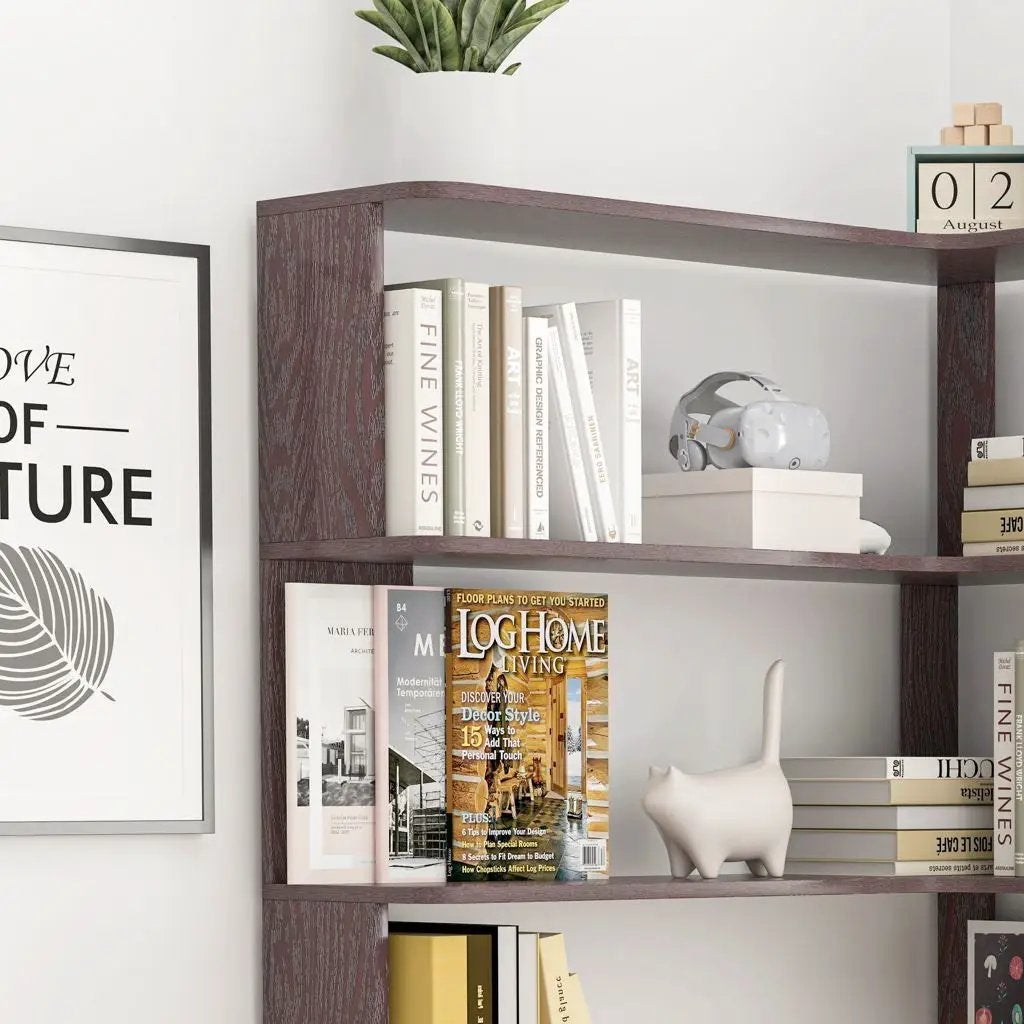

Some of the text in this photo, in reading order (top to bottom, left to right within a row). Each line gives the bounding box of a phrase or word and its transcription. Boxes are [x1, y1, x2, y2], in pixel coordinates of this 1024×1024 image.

[943, 219, 1003, 232] August
[420, 323, 437, 390] FINE
[626, 358, 640, 396] ART
[535, 337, 544, 498] GRAPHIC DESIGN REFERENCED
[421, 405, 438, 503] WINES
[0, 461, 152, 526] TURE
[1001, 517, 1024, 536] CAFÉ
[457, 593, 605, 608] FLOOR PLANS TO GET YOU STARTED
[501, 655, 565, 674] LIVING
[461, 691, 524, 703] DISCOVER YOUR
[462, 707, 540, 725] Decor Style
[998, 683, 1012, 742] FINE
[461, 725, 482, 747] 15
[485, 725, 516, 736] Ways to
[485, 738, 521, 748] Add That
[462, 750, 523, 760] Personal Touch
[998, 756, 1012, 845] WINES
[461, 813, 491, 823] PLUS:
[462, 828, 467, 836] 6
[468, 828, 479, 838] Tips
[488, 828, 512, 837] Improve
[513, 828, 526, 836] Your
[527, 828, 547, 837] Design
[936, 836, 959, 856] CAFÉ
[961, 836, 972, 851] LE
[468, 853, 489, 861] Secrets
[490, 853, 497, 861] to
[498, 852, 506, 860] Fit
[507, 852, 526, 861] Dream
[534, 852, 554, 862] Budget
[476, 865, 507, 875] Chopsticks
[508, 865, 525, 873] Affect
[526, 865, 537, 874] Log
[538, 864, 556, 873] Prices
